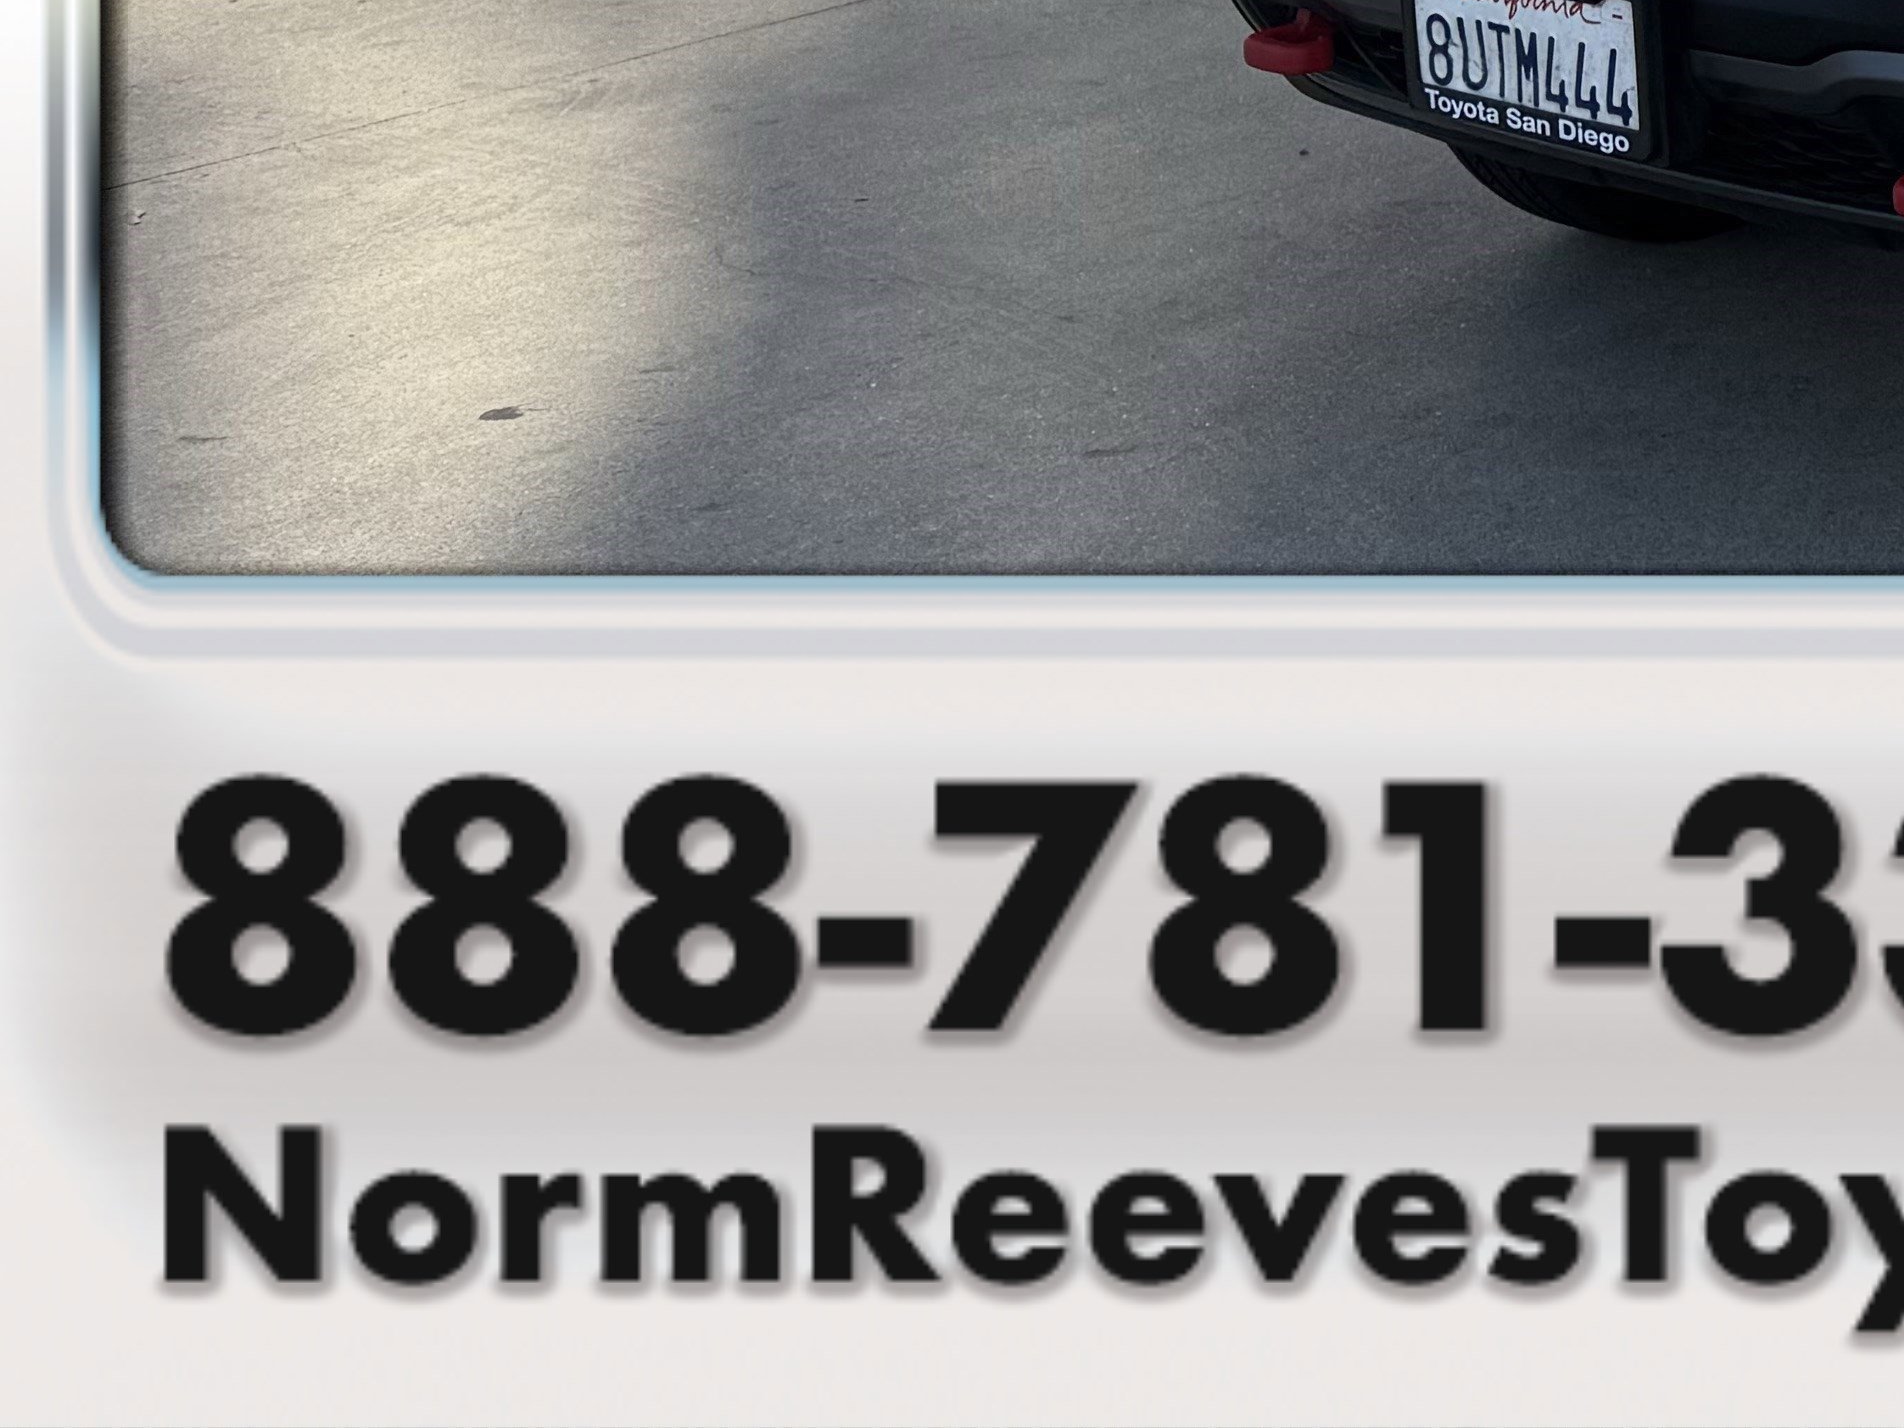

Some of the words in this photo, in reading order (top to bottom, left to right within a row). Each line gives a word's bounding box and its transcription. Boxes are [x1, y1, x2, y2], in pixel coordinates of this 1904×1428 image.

[1425, 12, 1634, 126] 8UTM444
[1424, 88, 1499, 124] Toyota
[1506, 107, 1551, 137] San
[1558, 119, 1630, 155] Diego
